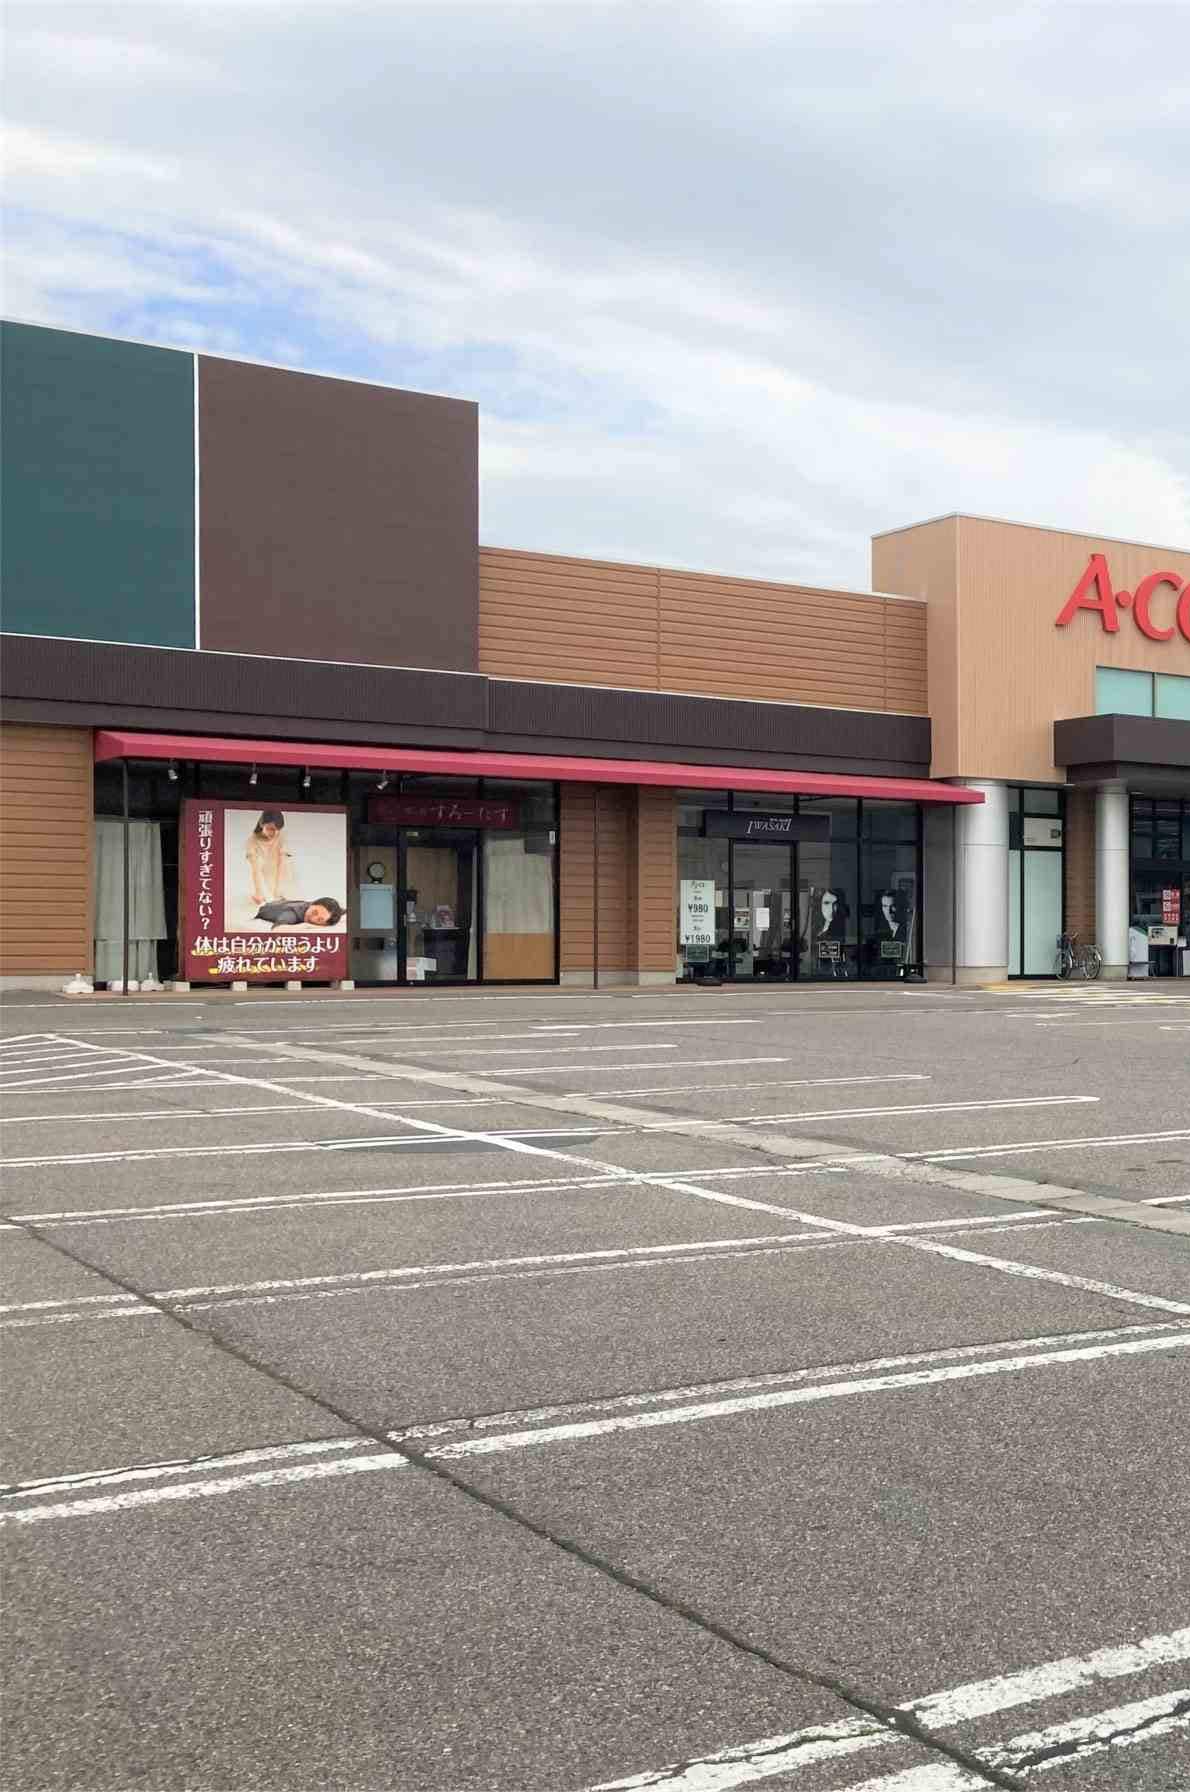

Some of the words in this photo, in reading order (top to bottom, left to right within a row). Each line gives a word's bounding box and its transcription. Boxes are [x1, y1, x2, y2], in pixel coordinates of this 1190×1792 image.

[193, 935, 340, 954] 体は自分が思うより
[216, 955, 320, 975] 疲れています
